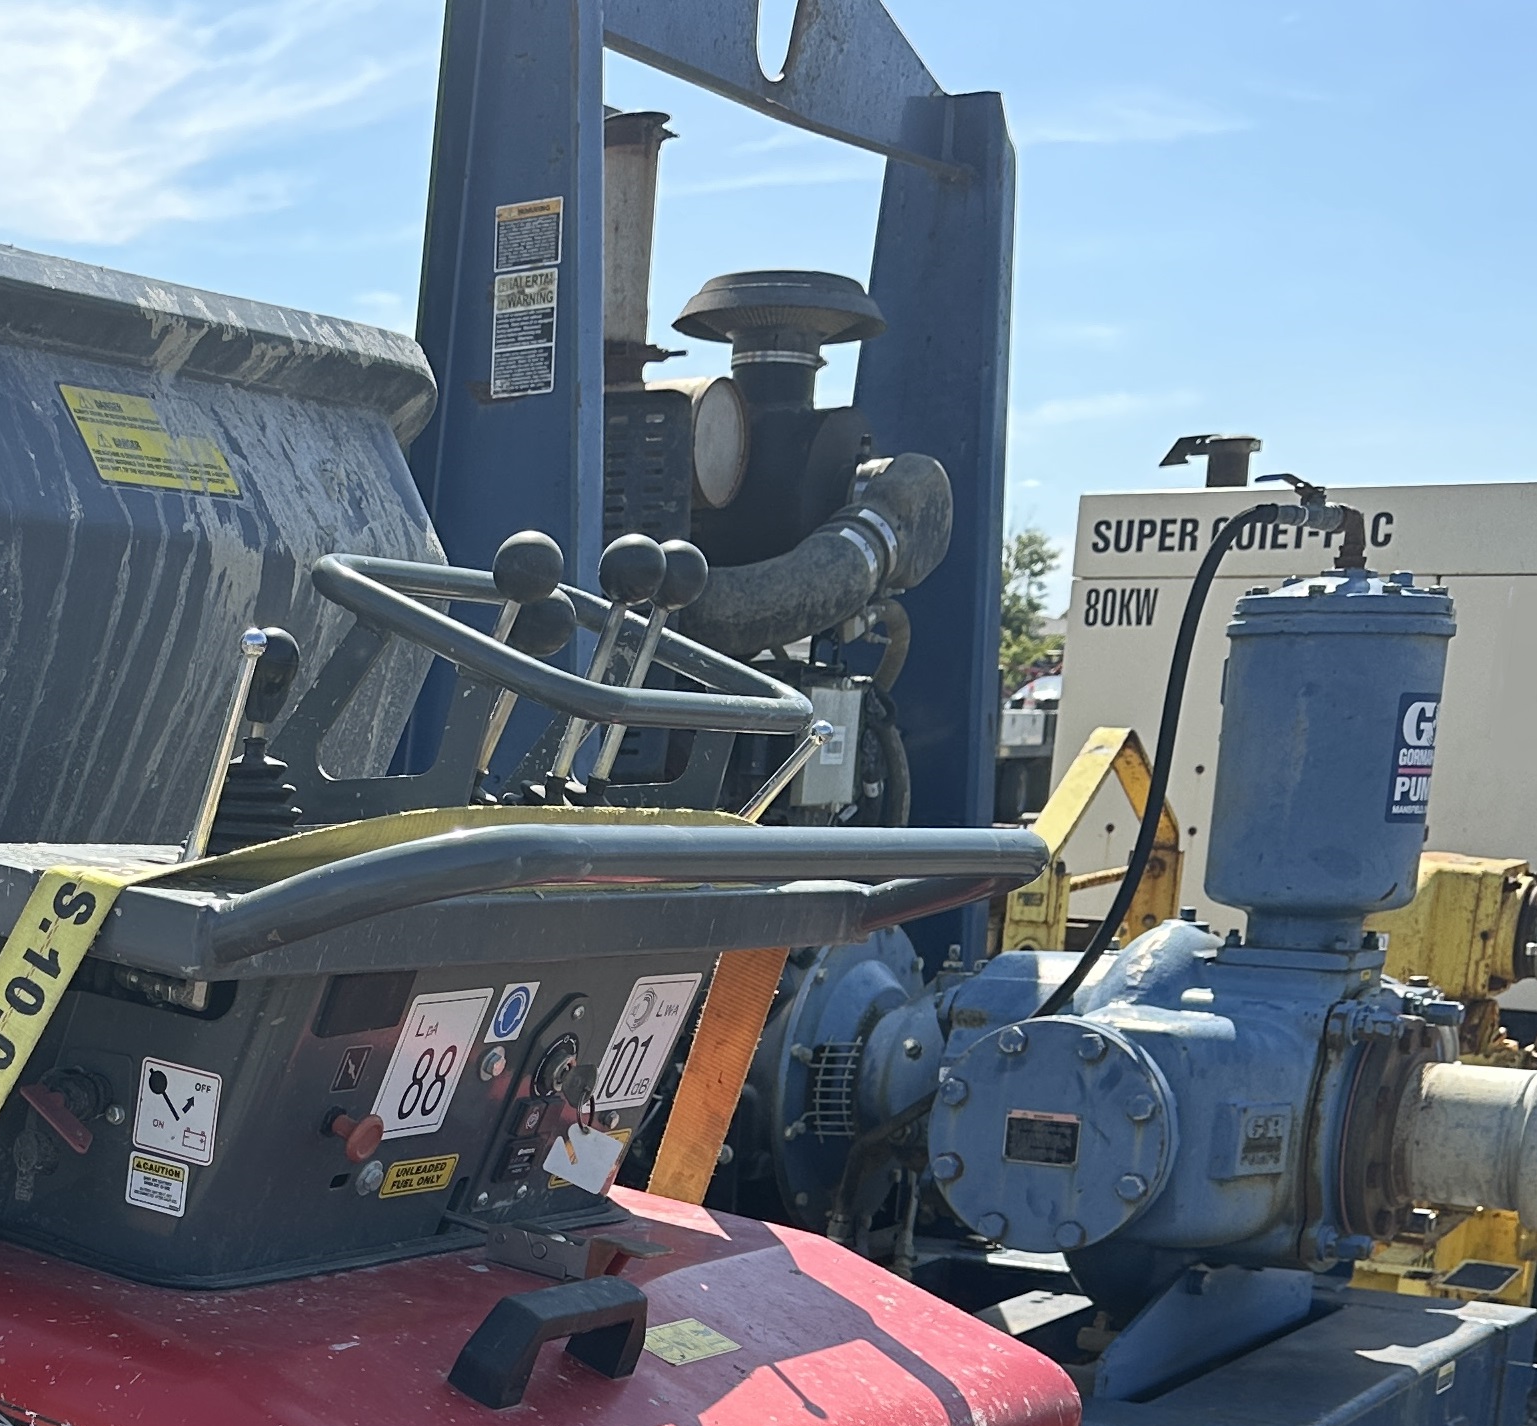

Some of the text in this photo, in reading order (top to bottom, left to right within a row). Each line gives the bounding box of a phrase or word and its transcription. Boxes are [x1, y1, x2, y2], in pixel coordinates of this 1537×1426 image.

[508, 290, 554, 308] WARNING
[1091, 517, 1199, 554] SUPER
[1083, 587, 1159, 627] 80KW
[596, 1034, 655, 1100] 101
[194, 1082, 212, 1094] OFF
[397, 1044, 458, 1121] 88
[152, 1118, 165, 1129] ON
[142, 1161, 181, 1179] CAUTION
[395, 1161, 448, 1178] UNLEADED
[390, 1173, 444, 1190] FUEL ONLY
